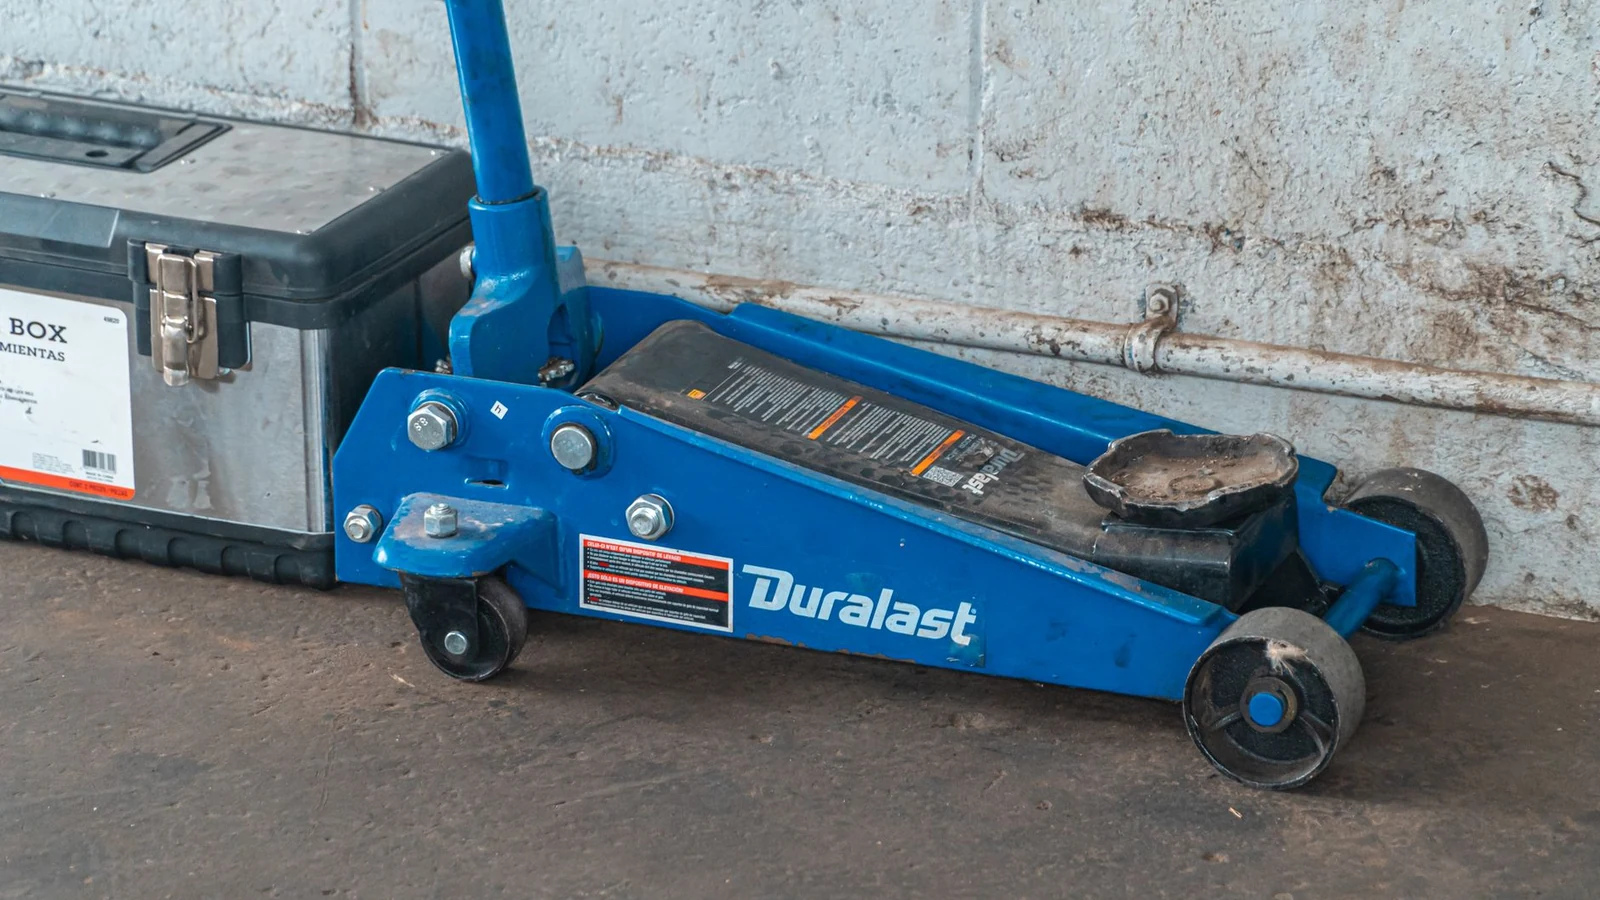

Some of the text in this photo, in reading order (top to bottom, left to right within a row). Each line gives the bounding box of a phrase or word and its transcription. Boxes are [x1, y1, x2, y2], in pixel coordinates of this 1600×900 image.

[9, 317, 68, 344] BOX
[653, 582, 658, 590] DE
[742, 564, 977, 646] Duralast
